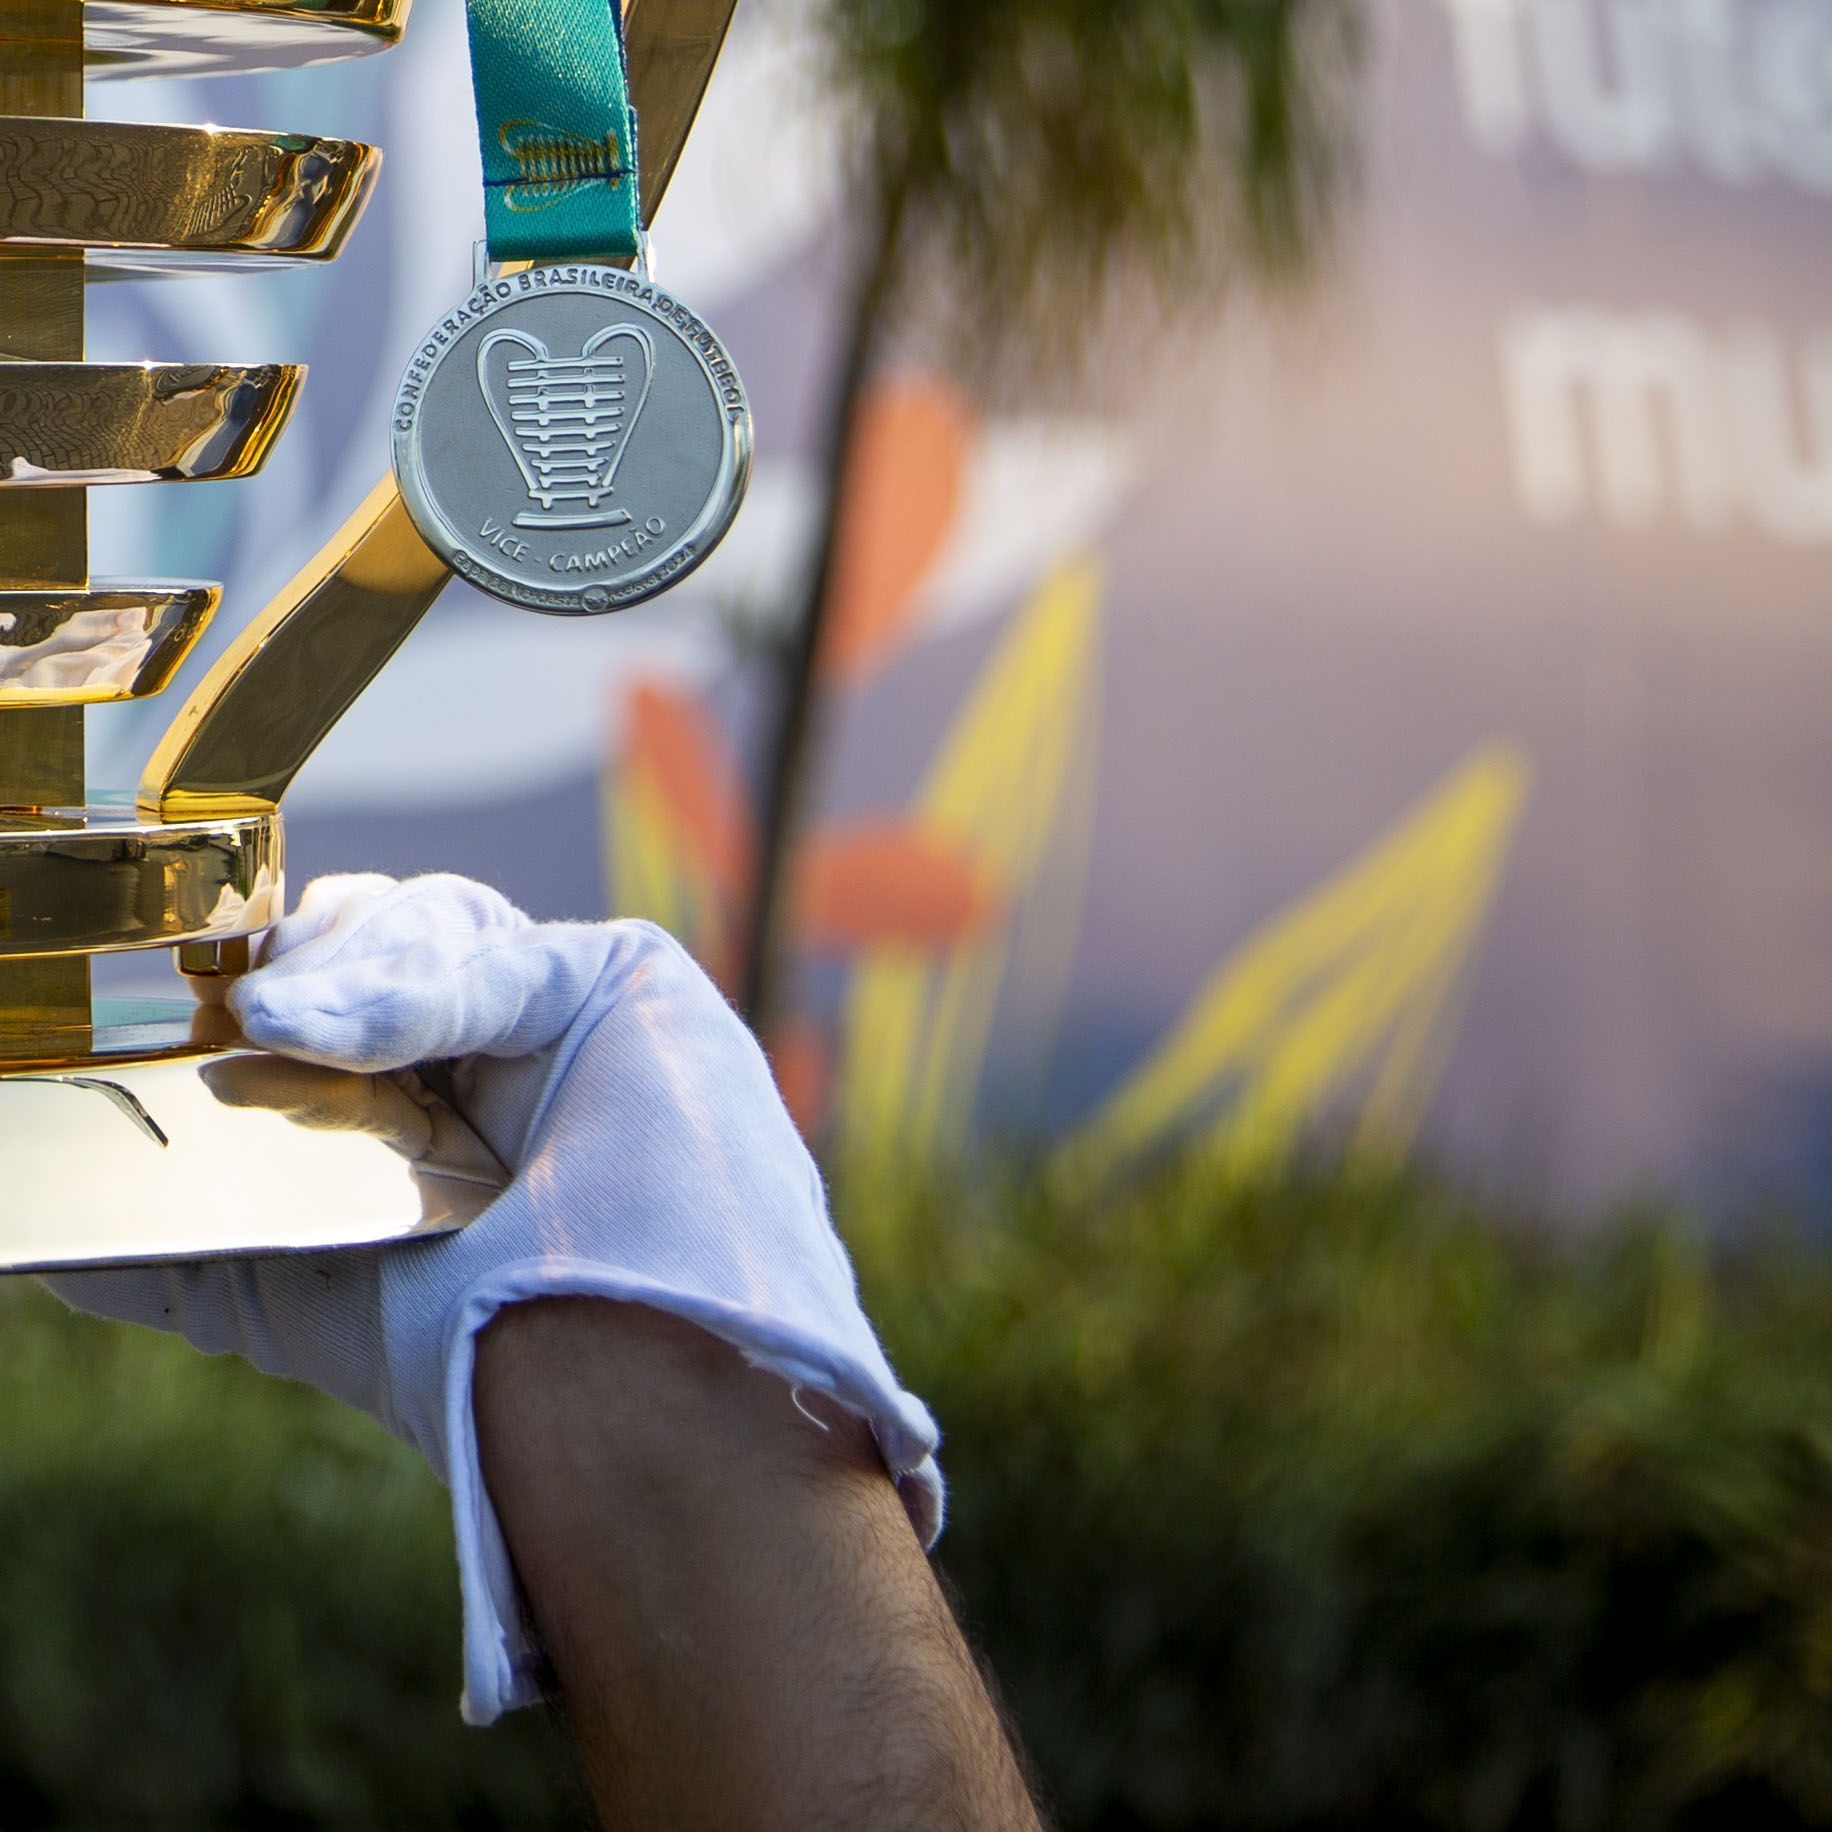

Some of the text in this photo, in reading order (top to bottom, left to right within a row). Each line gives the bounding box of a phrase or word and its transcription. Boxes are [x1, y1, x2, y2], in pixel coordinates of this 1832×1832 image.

[394, 268, 744, 433] CONFEDERAÇÃO BRASILEIRA DE FUTEBOL
[479, 516, 530, 563] VICE
[548, 516, 666, 573] CAMPEÃO
